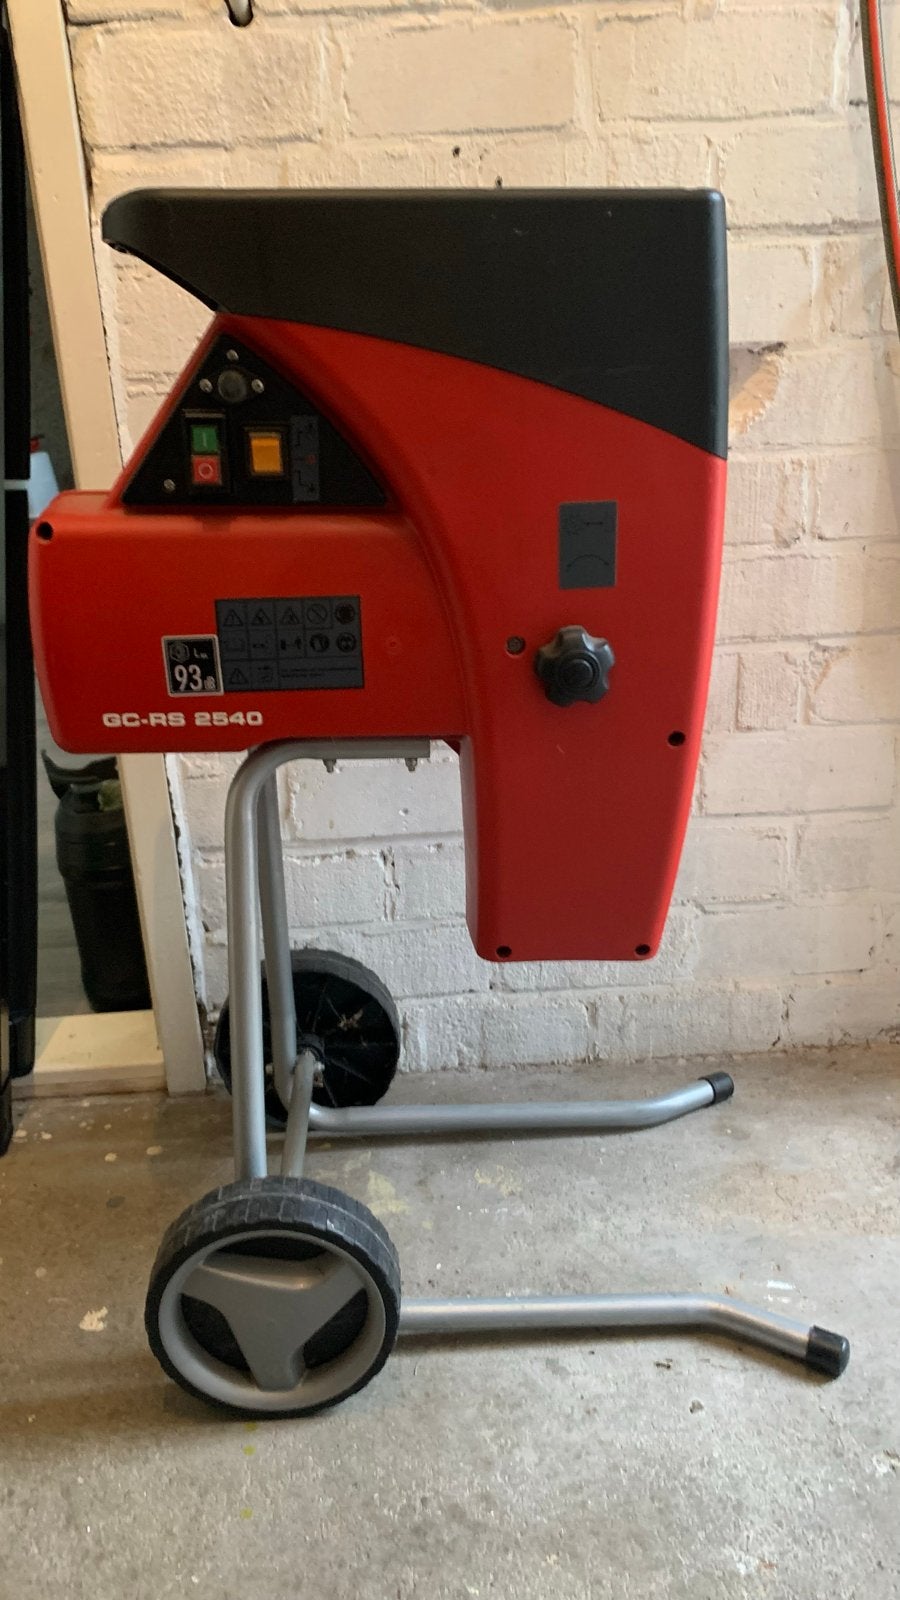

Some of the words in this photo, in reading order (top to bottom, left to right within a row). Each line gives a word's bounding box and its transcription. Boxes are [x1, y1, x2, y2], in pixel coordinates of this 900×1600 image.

[174, 664, 202, 691] 93
[102, 712, 186, 728] GC-RS
[194, 711, 264, 727] 2540
